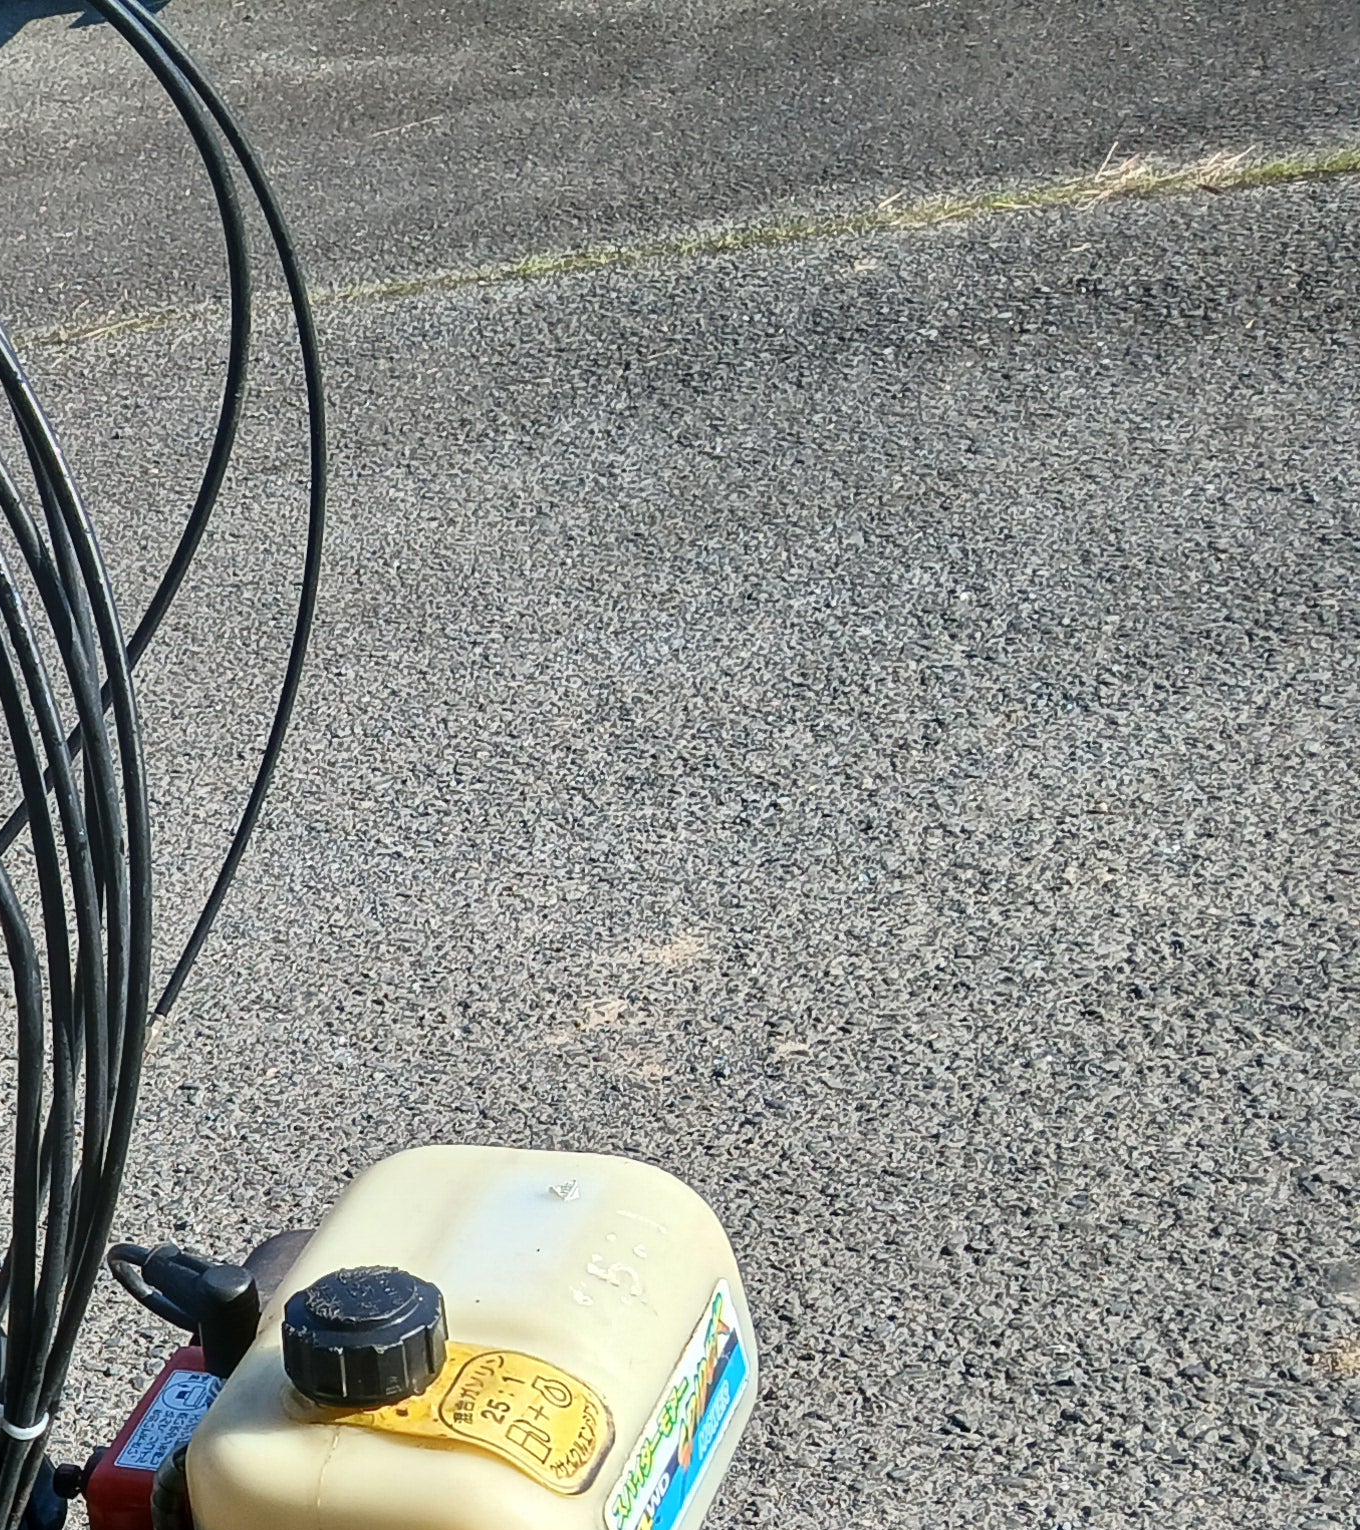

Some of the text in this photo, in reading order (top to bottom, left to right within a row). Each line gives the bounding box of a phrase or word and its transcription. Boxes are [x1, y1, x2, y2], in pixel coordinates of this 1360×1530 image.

[452, 1354, 505, 1425] 混合ガソリン
